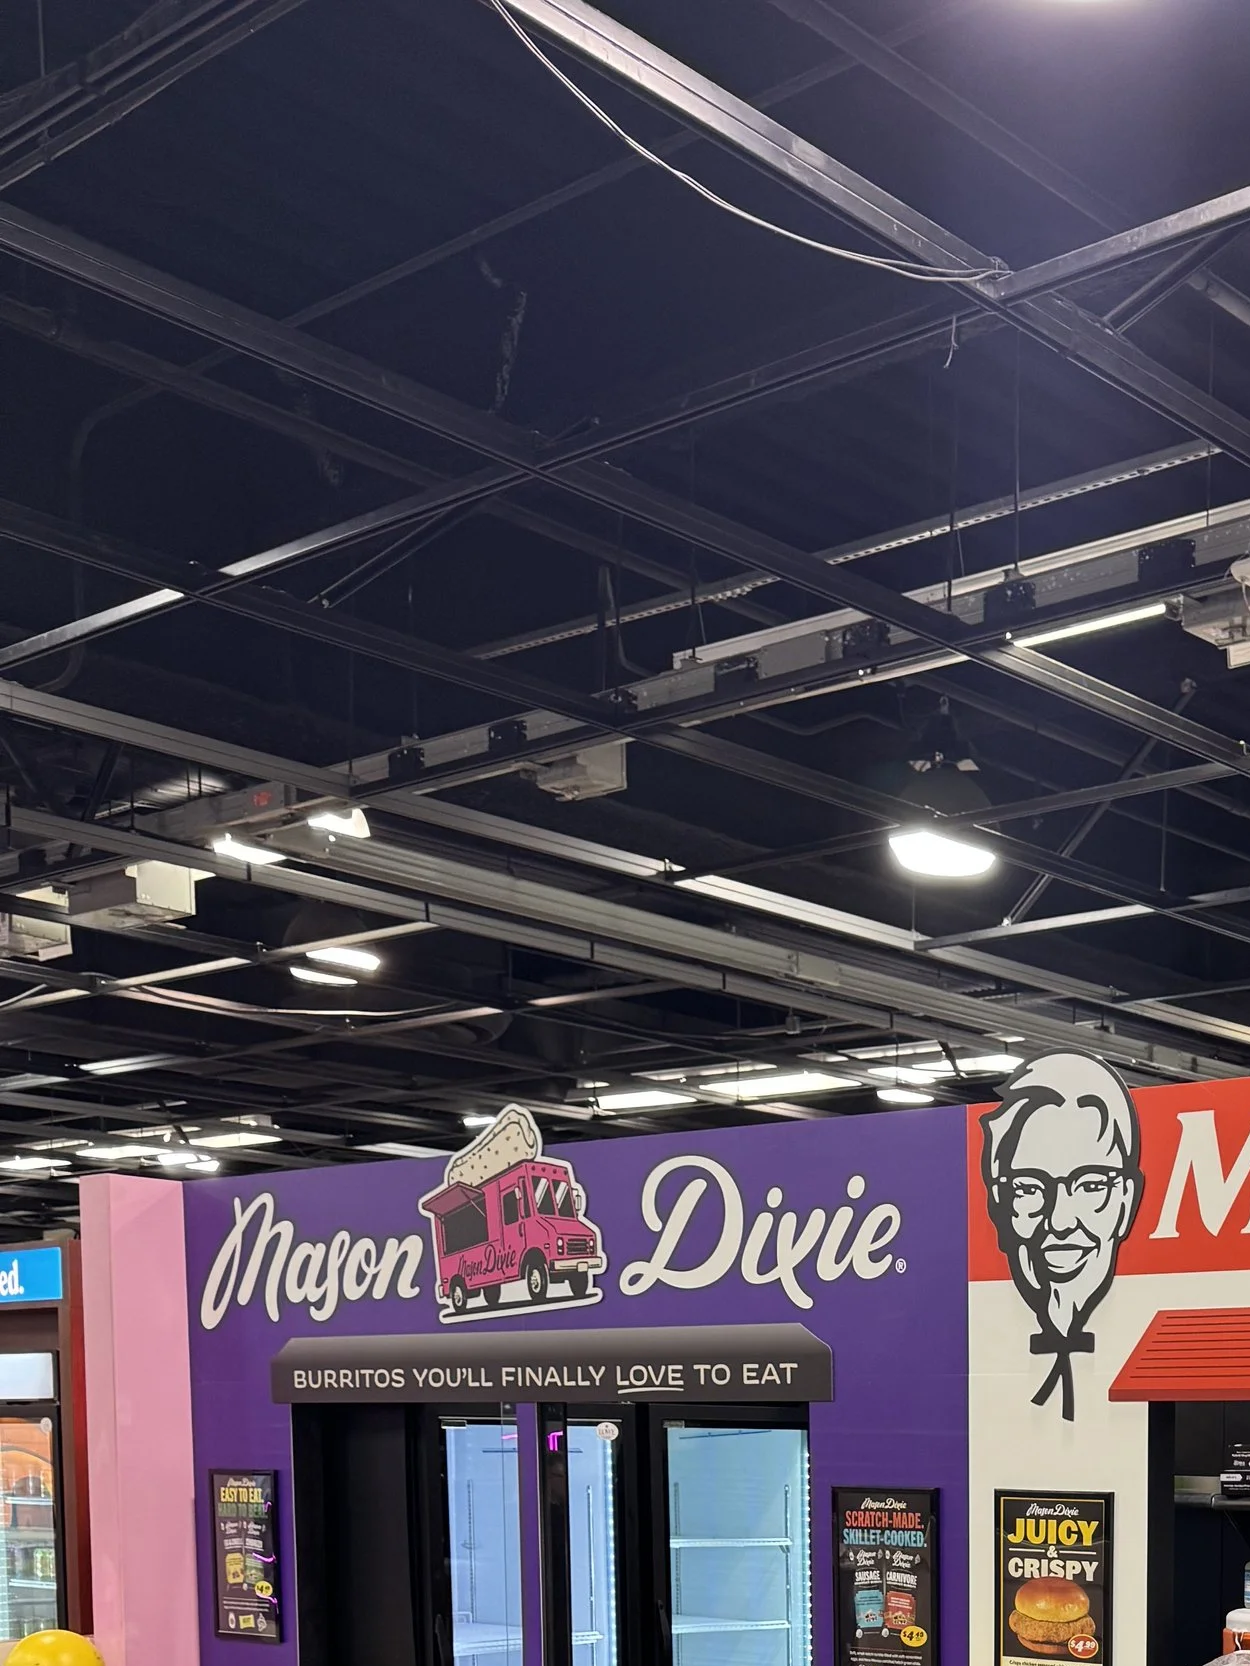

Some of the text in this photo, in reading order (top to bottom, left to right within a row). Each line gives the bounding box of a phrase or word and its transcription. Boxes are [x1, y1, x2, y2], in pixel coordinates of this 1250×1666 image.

[200, 1191, 424, 1331] Mason
[483, 1244, 518, 1276] Dixie
[293, 1362, 798, 1389] BURRITOS YOU'LL FINALLY LOVE TO EAT
[220, 1487, 264, 1503] EASY TO EAT.
[1026, 1503, 1080, 1517] Mason Dixie
[845, 1511, 924, 1529] SCRATCH-MADE.
[843, 1528, 927, 1547] SKILLET-COOKED.
[1007, 1518, 1099, 1546] JUICY
[1046, 1545, 1058, 1558] &
[855, 1571, 880, 1582] SAUSAGE
[886, 1571, 918, 1585] CARNIVORE
[1008, 1557, 1099, 1582] CRISPY
